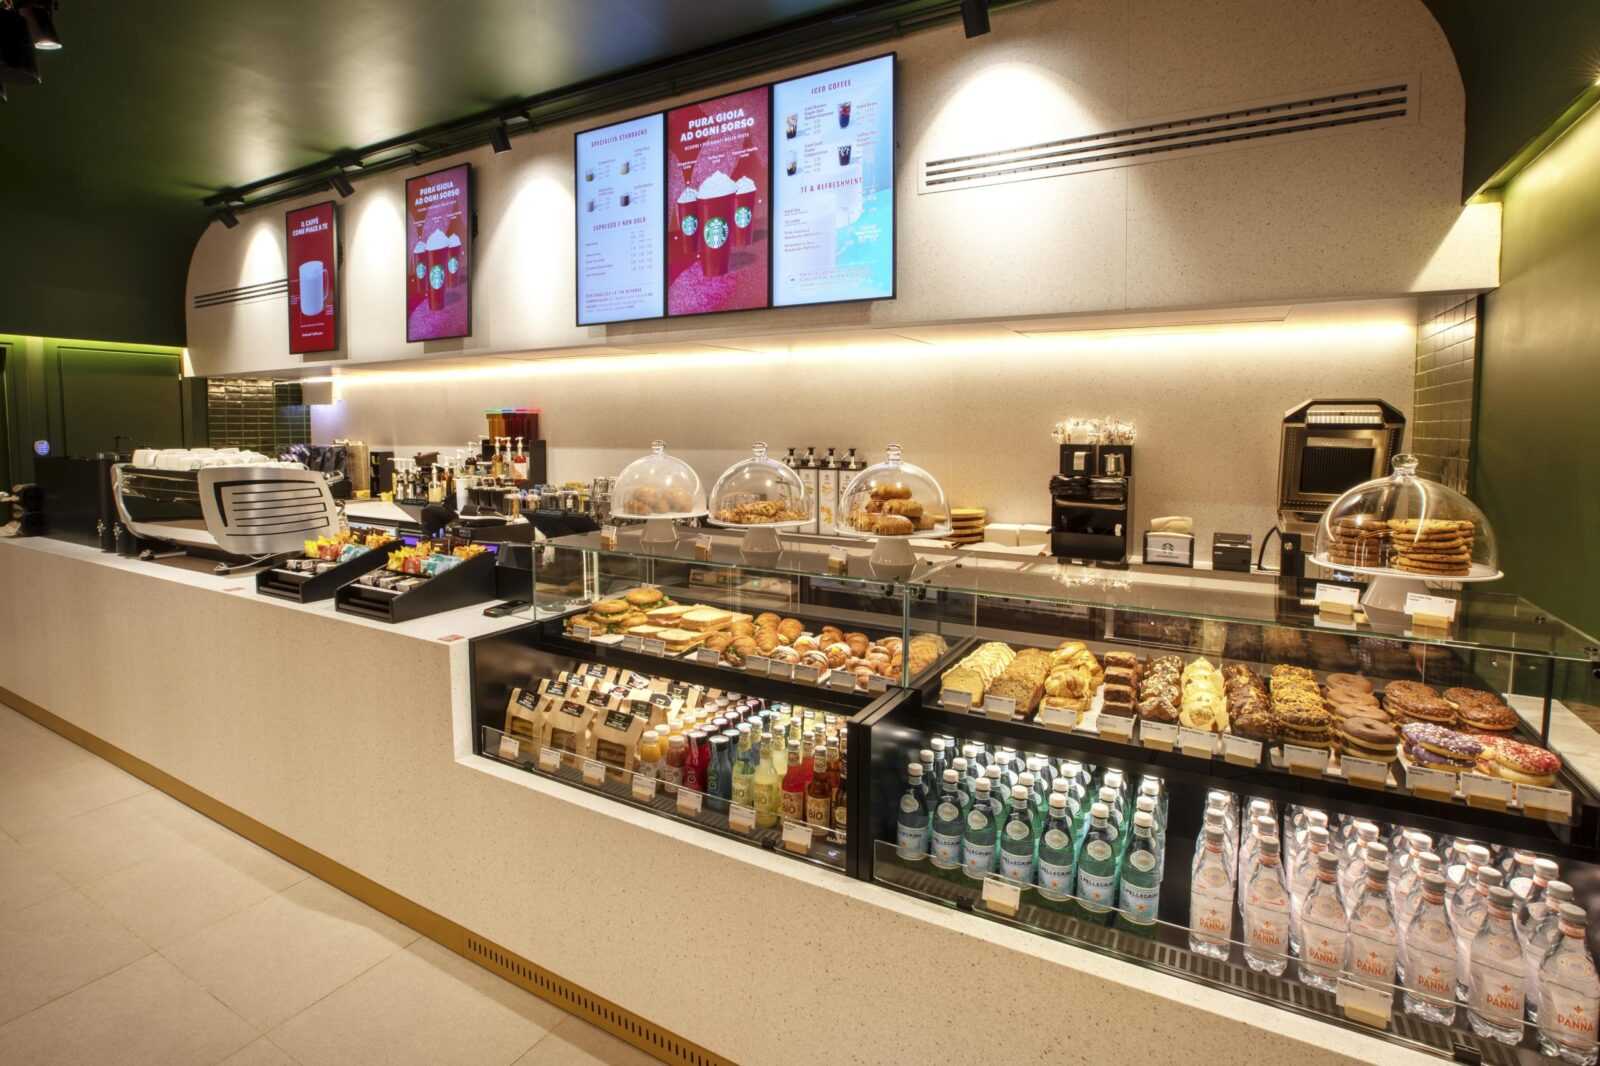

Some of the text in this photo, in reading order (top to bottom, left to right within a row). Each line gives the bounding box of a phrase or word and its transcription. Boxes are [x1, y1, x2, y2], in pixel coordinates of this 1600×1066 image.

[828, 79, 851, 91] COFFEE
[688, 108, 744, 129] PURA GIOIA
[680, 131, 694, 142] AD
[695, 125, 720, 138] OGNI
[721, 117, 755, 132] SORSO
[808, 808, 823, 820] BIO
[1200, 917, 1226, 931] PANNA
[1253, 928, 1280, 945] PANNA
[1309, 947, 1338, 964] PANNA
[1356, 959, 1387, 977] PANNA
[1418, 975, 1450, 992] PANNA
[1557, 1013, 1594, 1032] PANNA
